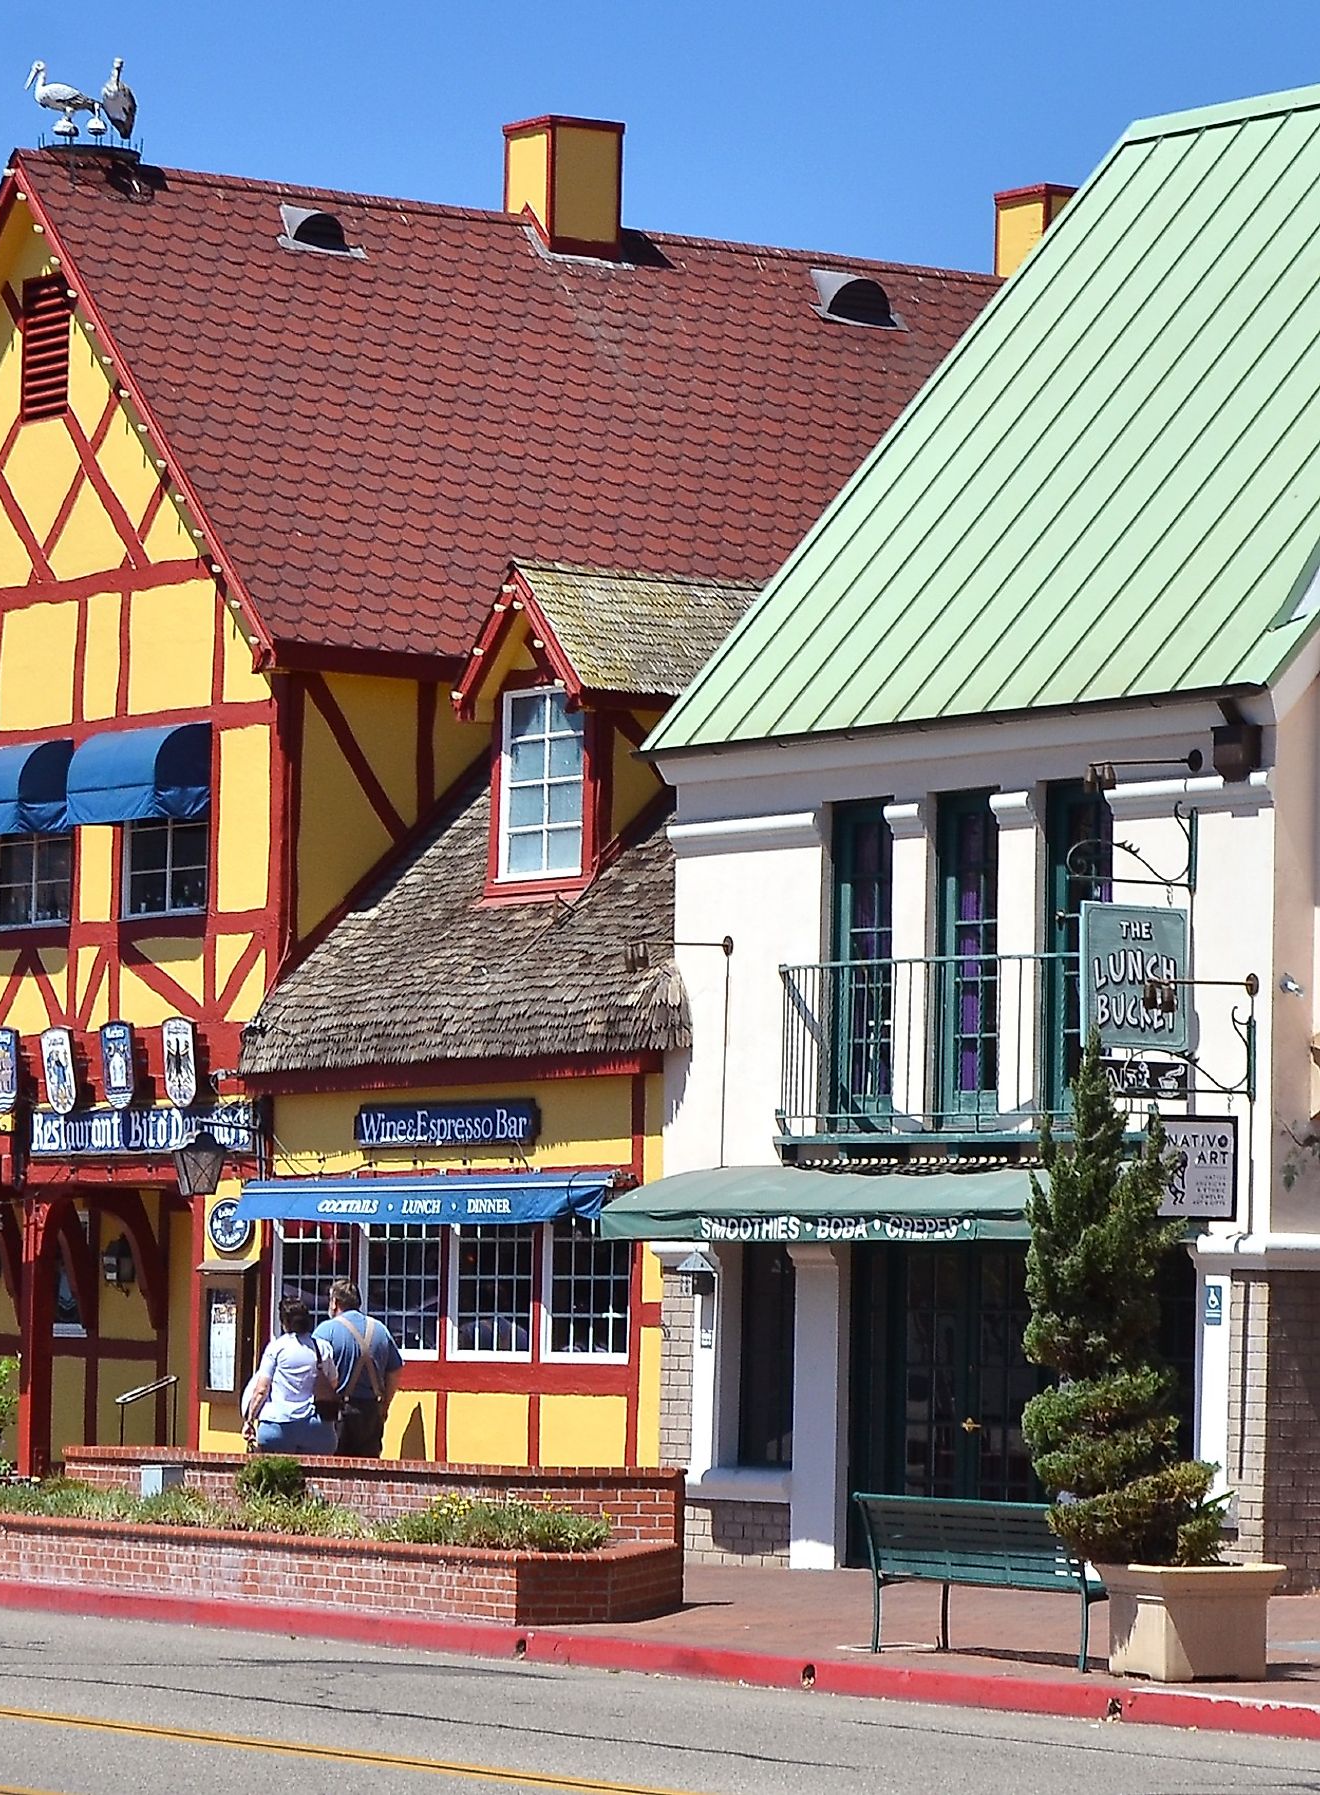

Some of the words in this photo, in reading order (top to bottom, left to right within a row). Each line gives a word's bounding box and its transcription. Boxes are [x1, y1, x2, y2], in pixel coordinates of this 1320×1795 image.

[1120, 920, 1152, 939] THE
[1094, 949, 1177, 990] LUNCH
[31, 1111, 120, 1150] Restaurant
[129, 1110, 156, 1147] Bit
[495, 1109, 527, 1139] Bar
[1197, 1151, 1228, 1165] ART
[317, 1199, 379, 1214] COCKTAILS
[401, 1199, 441, 1214] LUNCH
[467, 1198, 511, 1214] DINNER
[700, 1216, 800, 1240] SMOOTHIES
[816, 1217, 867, 1239] BOBA
[885, 1216, 958, 1239] CREPES
